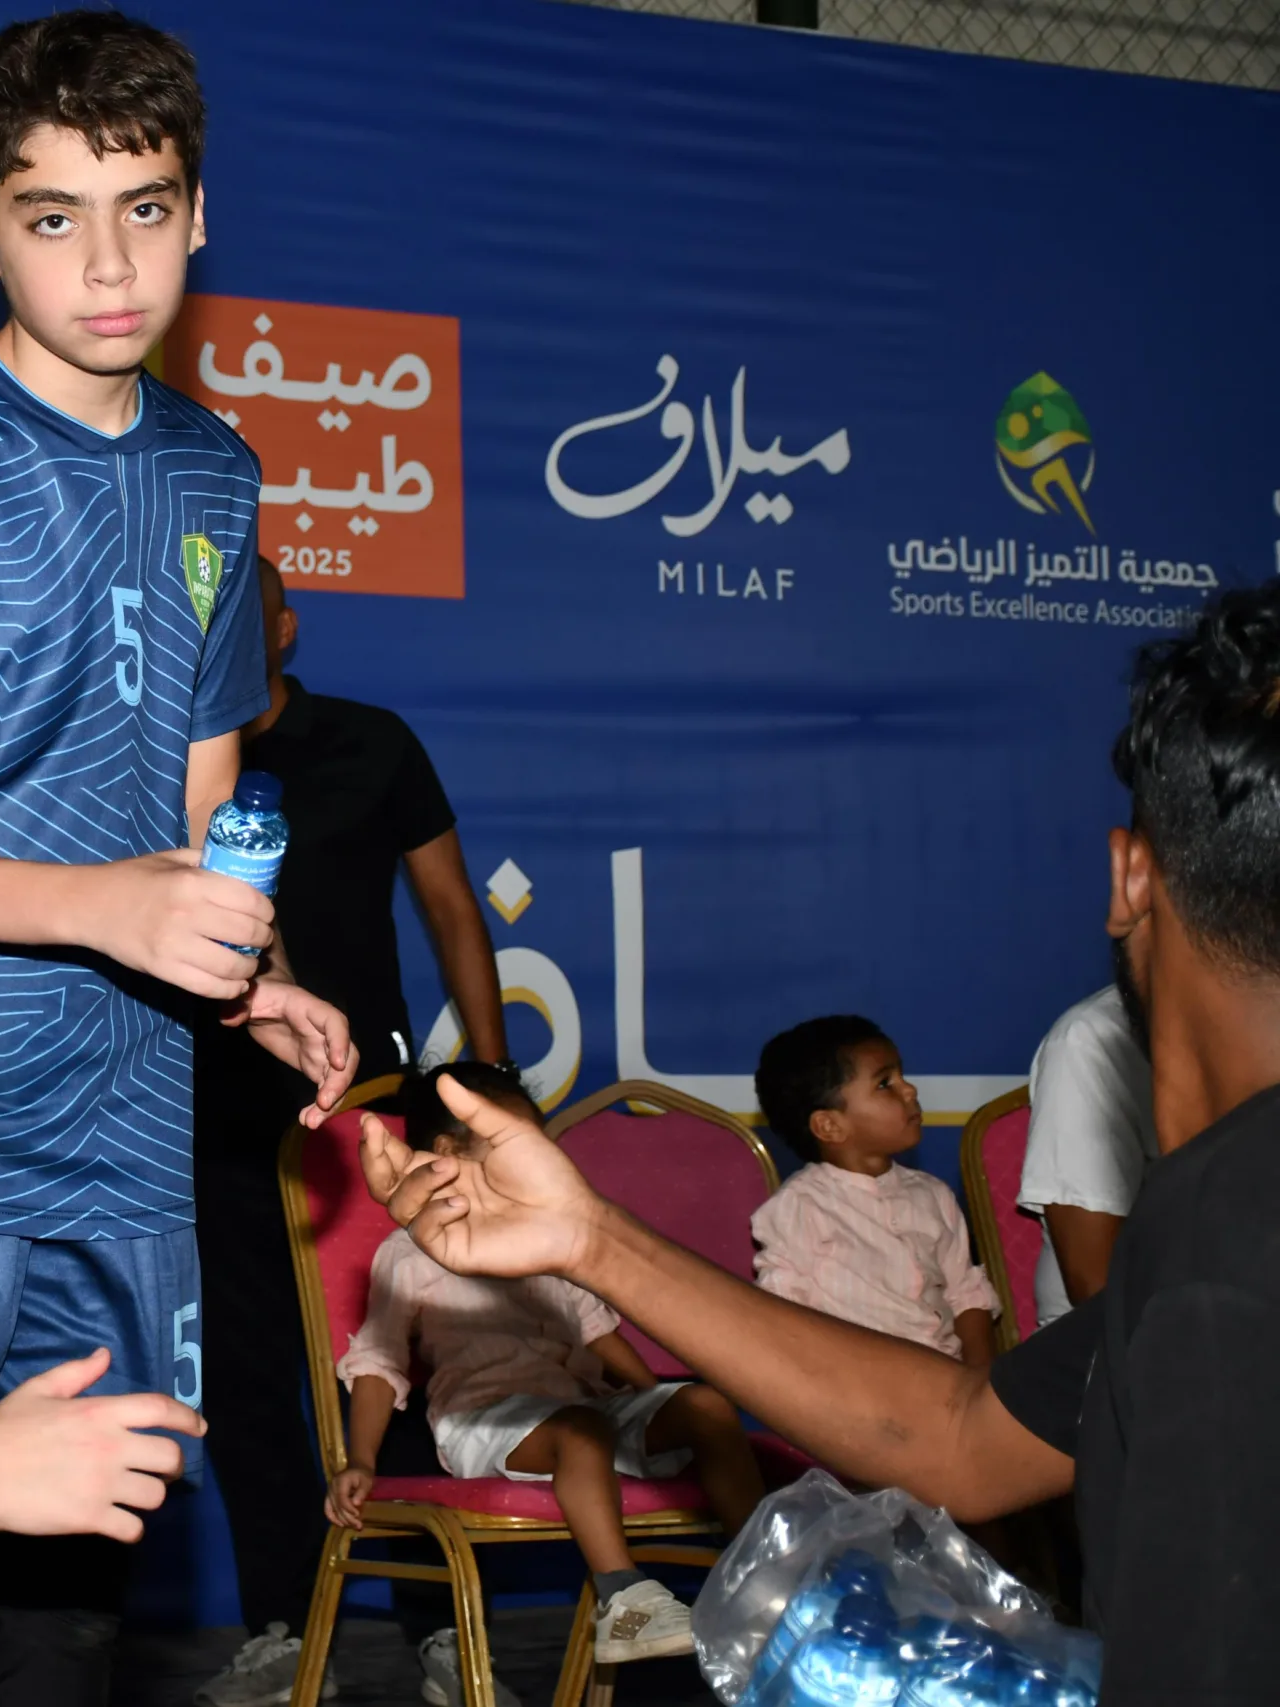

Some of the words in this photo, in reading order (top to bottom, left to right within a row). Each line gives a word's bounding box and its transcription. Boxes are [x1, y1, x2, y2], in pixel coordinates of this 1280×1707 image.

[198, 313, 431, 431] صيف
[278, 545, 352, 576] 2025
[658, 559, 794, 601] MILAF
[888, 535, 1017, 584] الرياضي
[1024, 543, 1110, 587] التميز
[1118, 549, 1219, 597] جمعية
[889, 586, 965, 617] Sports
[970, 590, 1089, 624] Excellence
[111, 586, 143, 707] 5
[174, 1302, 202, 1409] 5
